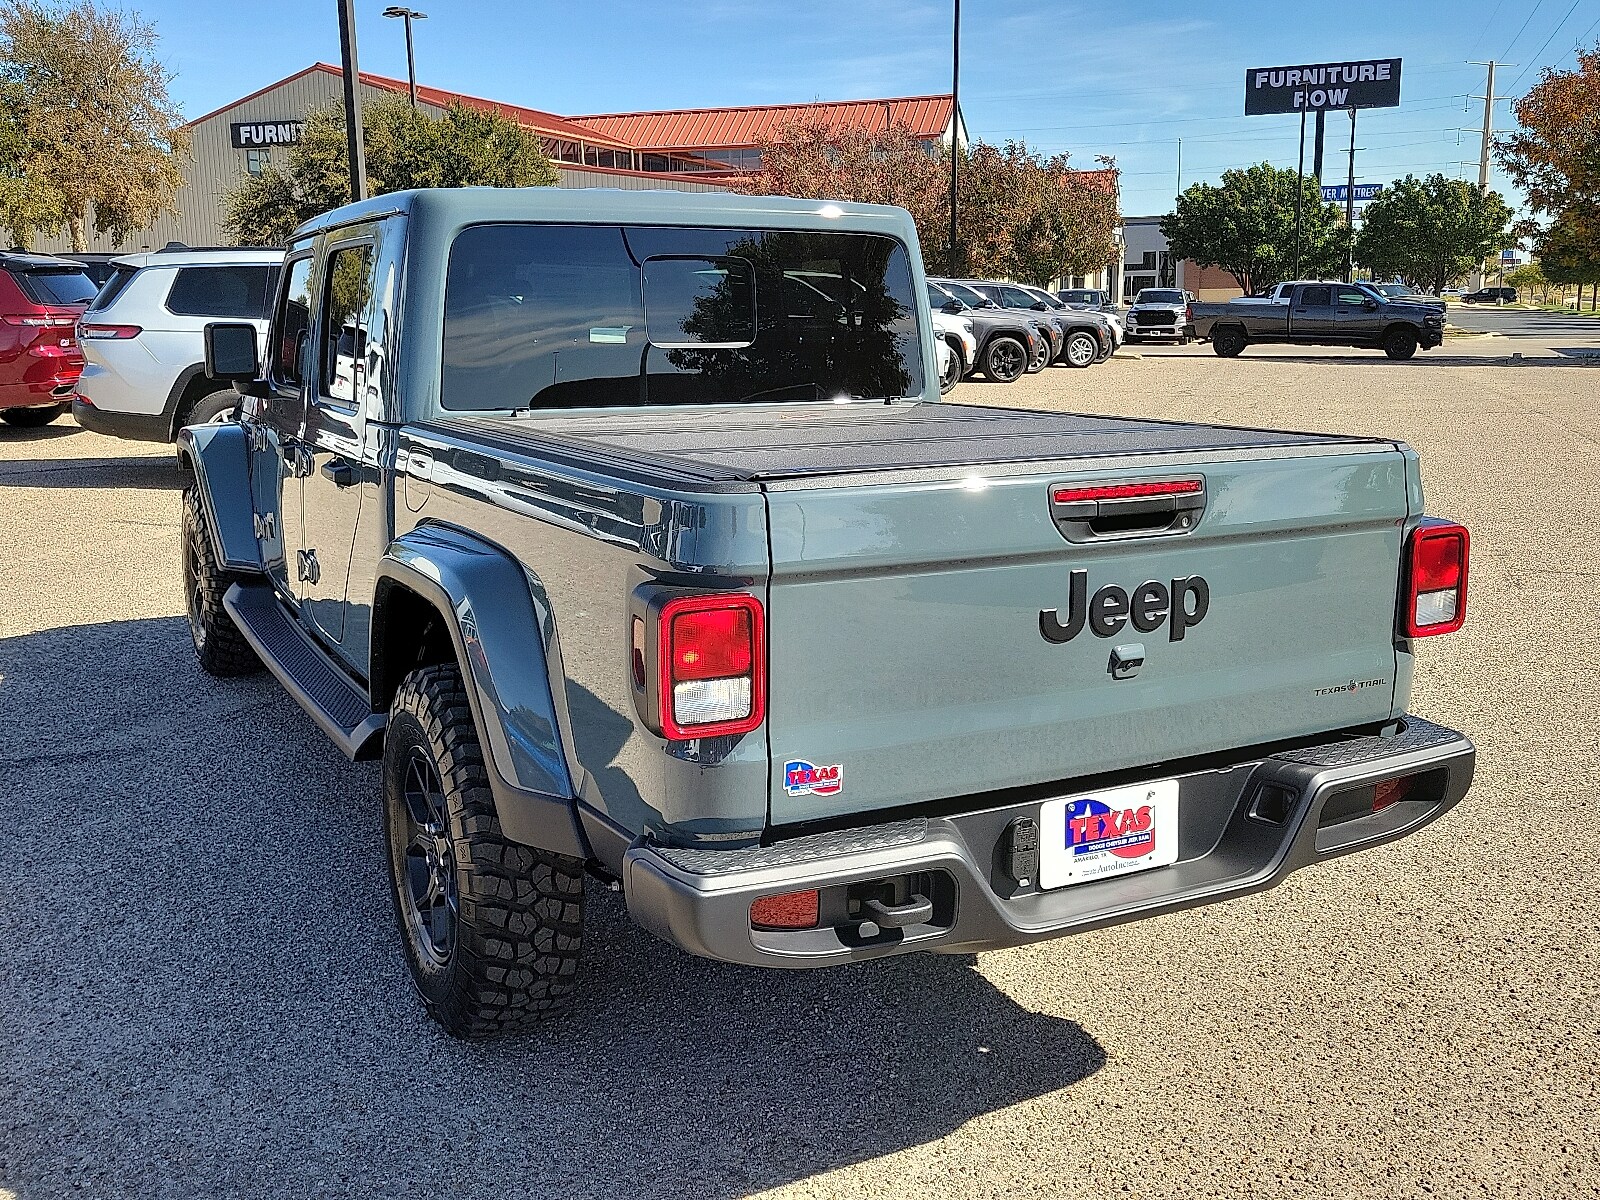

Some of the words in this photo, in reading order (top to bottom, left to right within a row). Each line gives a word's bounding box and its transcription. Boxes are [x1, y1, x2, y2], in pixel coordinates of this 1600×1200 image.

[1255, 63, 1391, 89] FURNITURE
[1293, 88, 1349, 108] ROW
[1340, 186, 1380, 199] MTTRESS
[1039, 569, 1210, 644] Jeep
[1314, 685, 1347, 697] TEXAS
[1359, 679, 1387, 689] TRAIL
[788, 766, 839, 785] TEXAS
[1069, 805, 1152, 843] TEXAS
